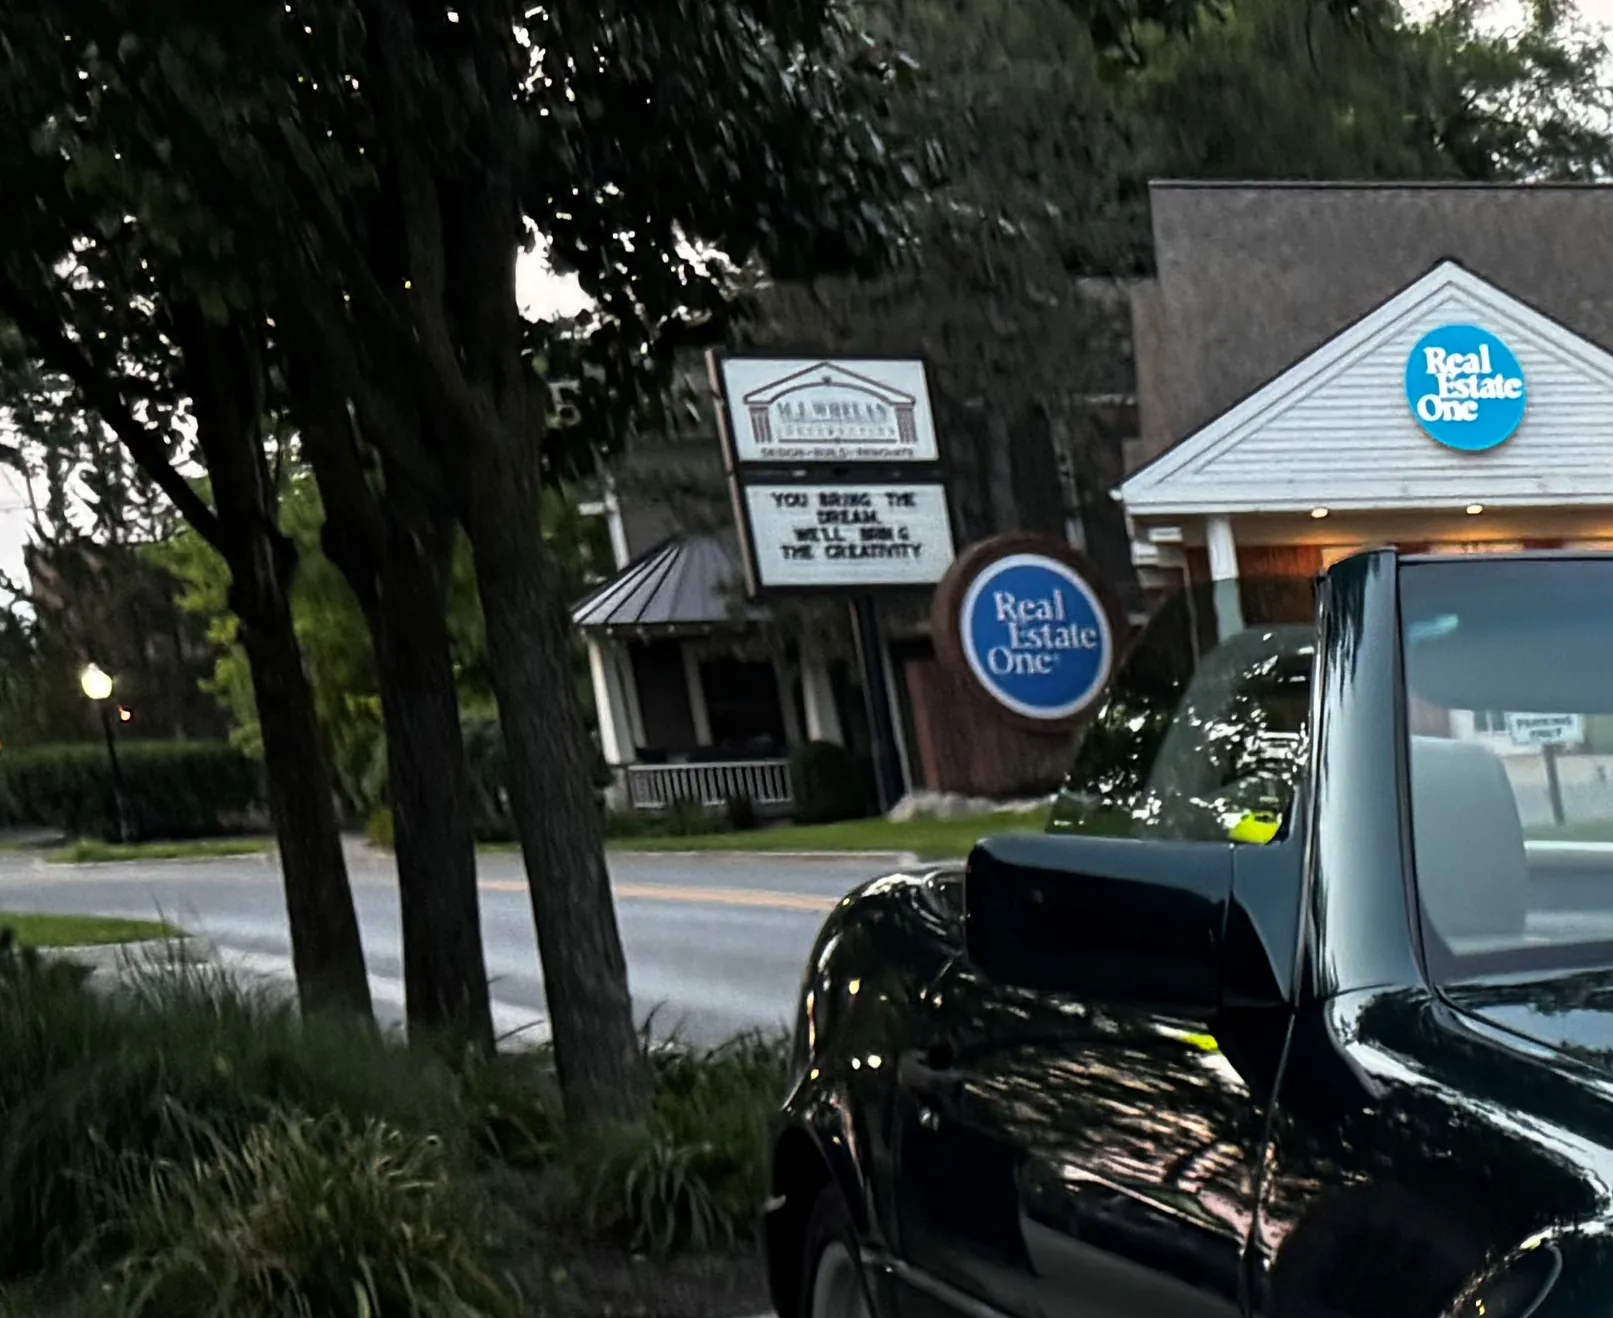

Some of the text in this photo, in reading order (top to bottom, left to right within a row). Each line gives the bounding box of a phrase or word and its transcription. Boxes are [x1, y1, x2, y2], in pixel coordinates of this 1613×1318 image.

[1422, 343, 1493, 376] Real
[1435, 373, 1523, 399] Estate
[1417, 394, 1479, 421] One
[772, 492, 916, 508] YOU BRING THE
[860, 526, 909, 541] BRING
[781, 543, 922, 561] THE CREATIVITY
[993, 587, 1066, 623] Real
[1008, 622, 1097, 649] Estate
